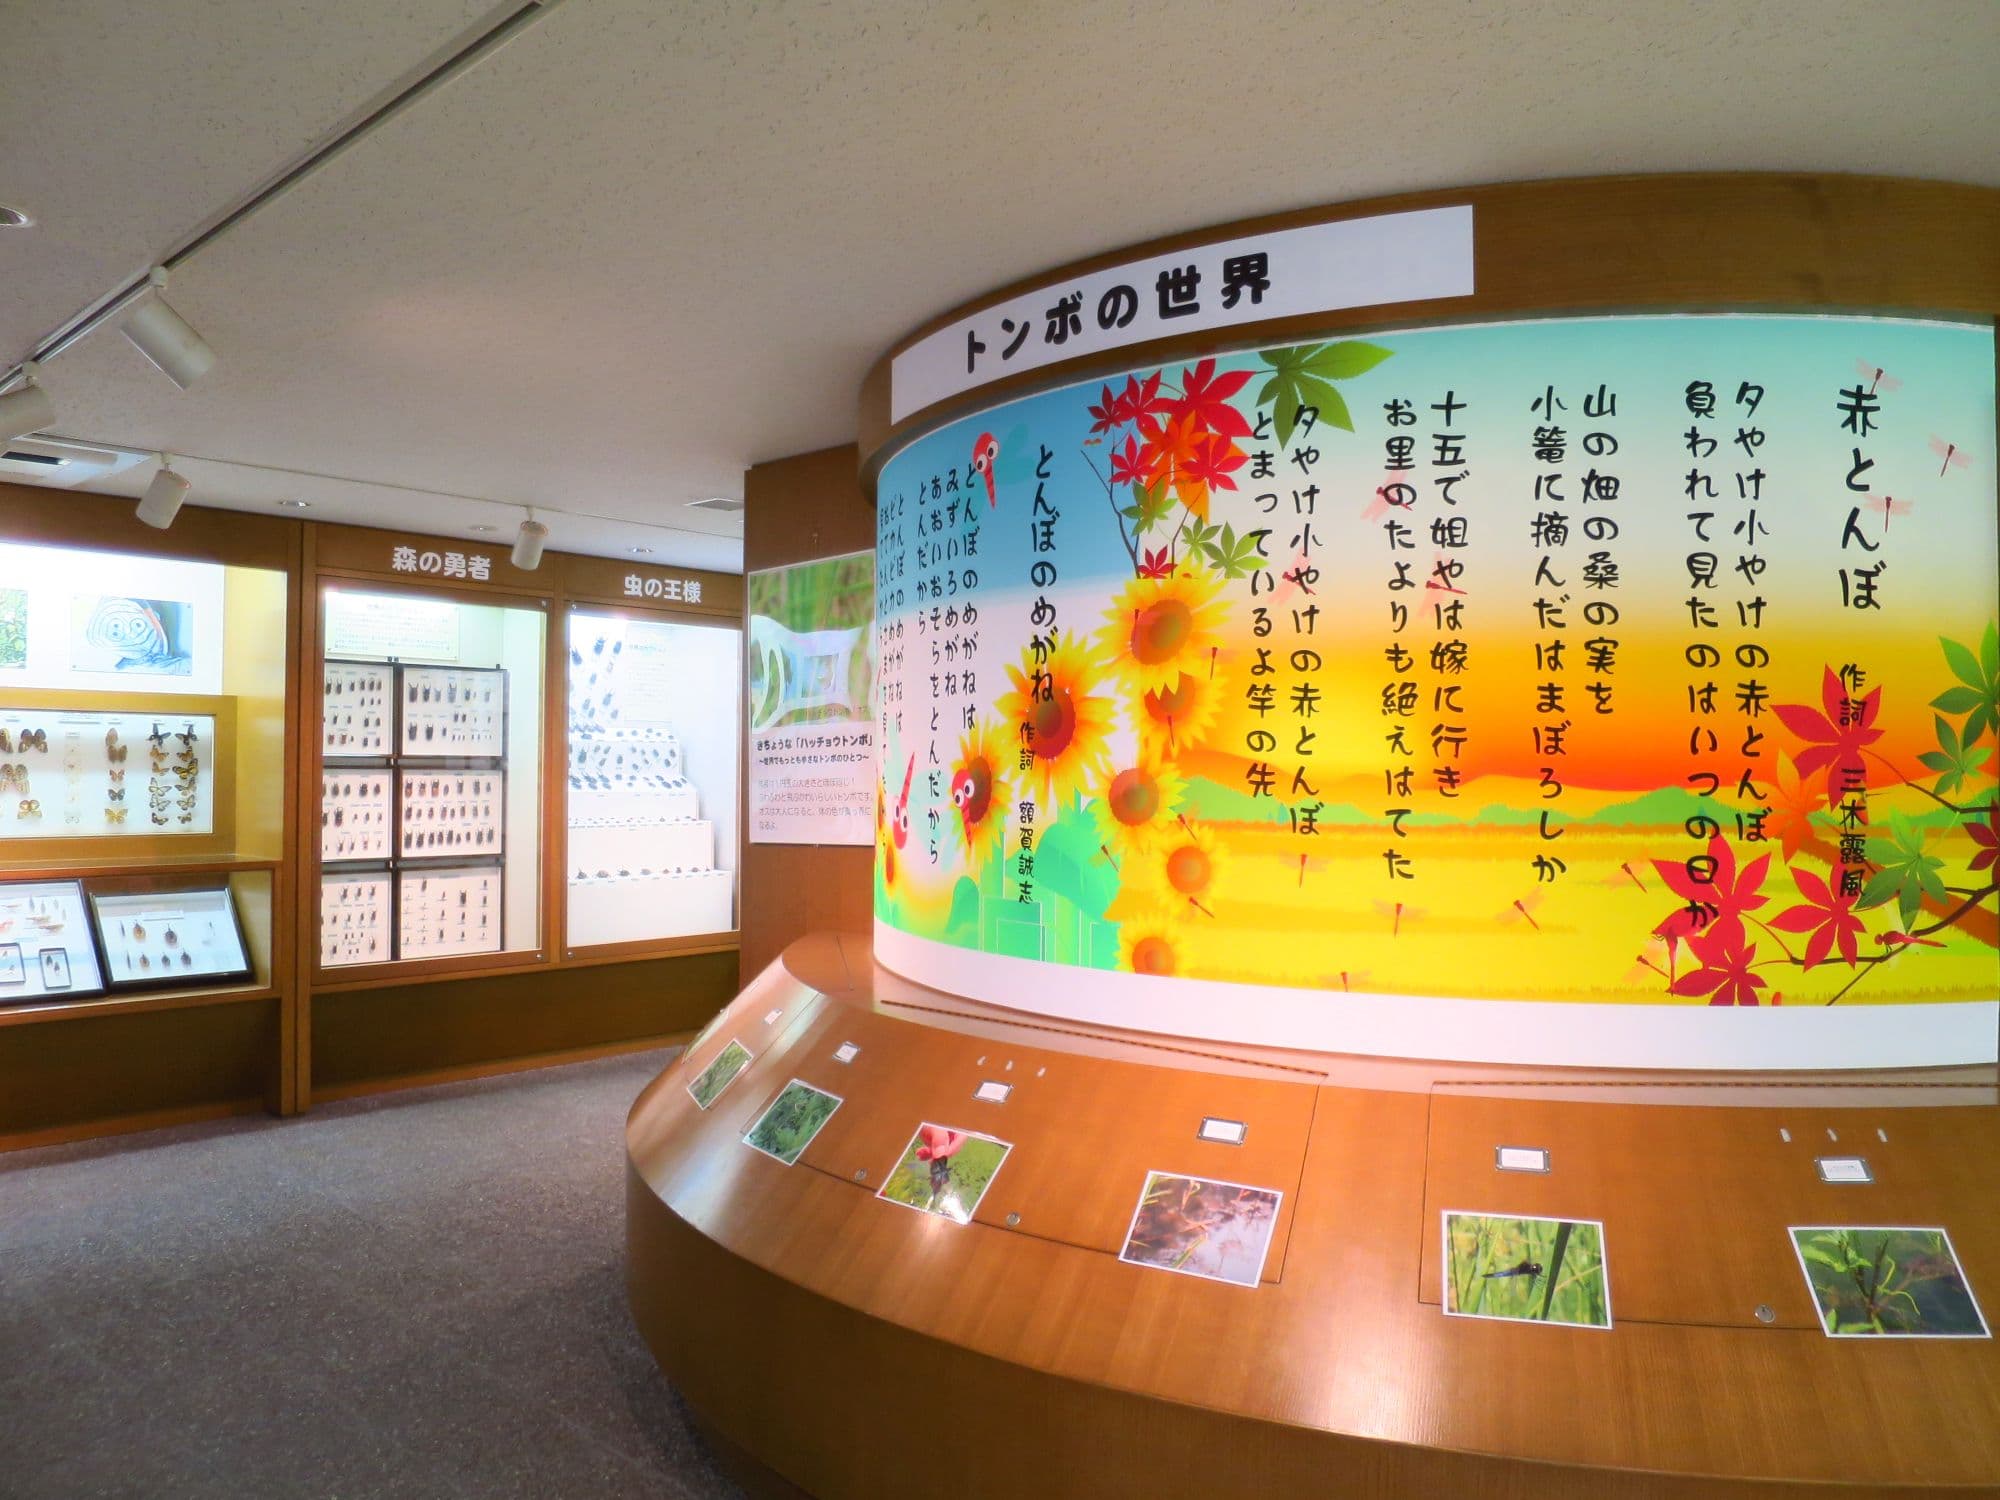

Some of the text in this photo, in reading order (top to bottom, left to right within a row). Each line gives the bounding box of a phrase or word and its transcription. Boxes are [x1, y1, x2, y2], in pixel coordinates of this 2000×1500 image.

[967, 252, 1271, 374] トンボの世界
[392, 546, 490, 580] 森の勇者
[624, 574, 701, 603] 虫の王様
[895, 493, 906, 733] とんぼのめがねは
[916, 481, 929, 635] とんだから
[945, 468, 961, 696] みずいろめがね
[962, 463, 979, 729] とんぼのめがねは
[1030, 444, 1060, 704] とんぼのめがね
[1245, 410, 1278, 798] とまっているよ竿の先
[1289, 403, 1324, 836] 夕やけ小やけの赤とんぼ
[1430, 391, 1469, 798] 十五で姐やは嫁に行き
[1581, 384, 1620, 715] 山の畑の桑の実を
[1733, 381, 1771, 843] 夕やけ小やけの赤とんぼ
[1837, 385, 1887, 610] 赤とんぼ
[757, 734, 873, 751] きちょうな「ハッチョウトンボ」
[928, 475, 943, 864] あおいおそらをとんだから
[1381, 398, 1419, 880] お里のたよりも絶えはてた
[1685, 380, 1720, 930] 負われて見たのはいつの日か
[1018, 721, 1036, 905] 作詞 額賀誠志
[1839, 663, 1867, 897] 作詞 三木露風
